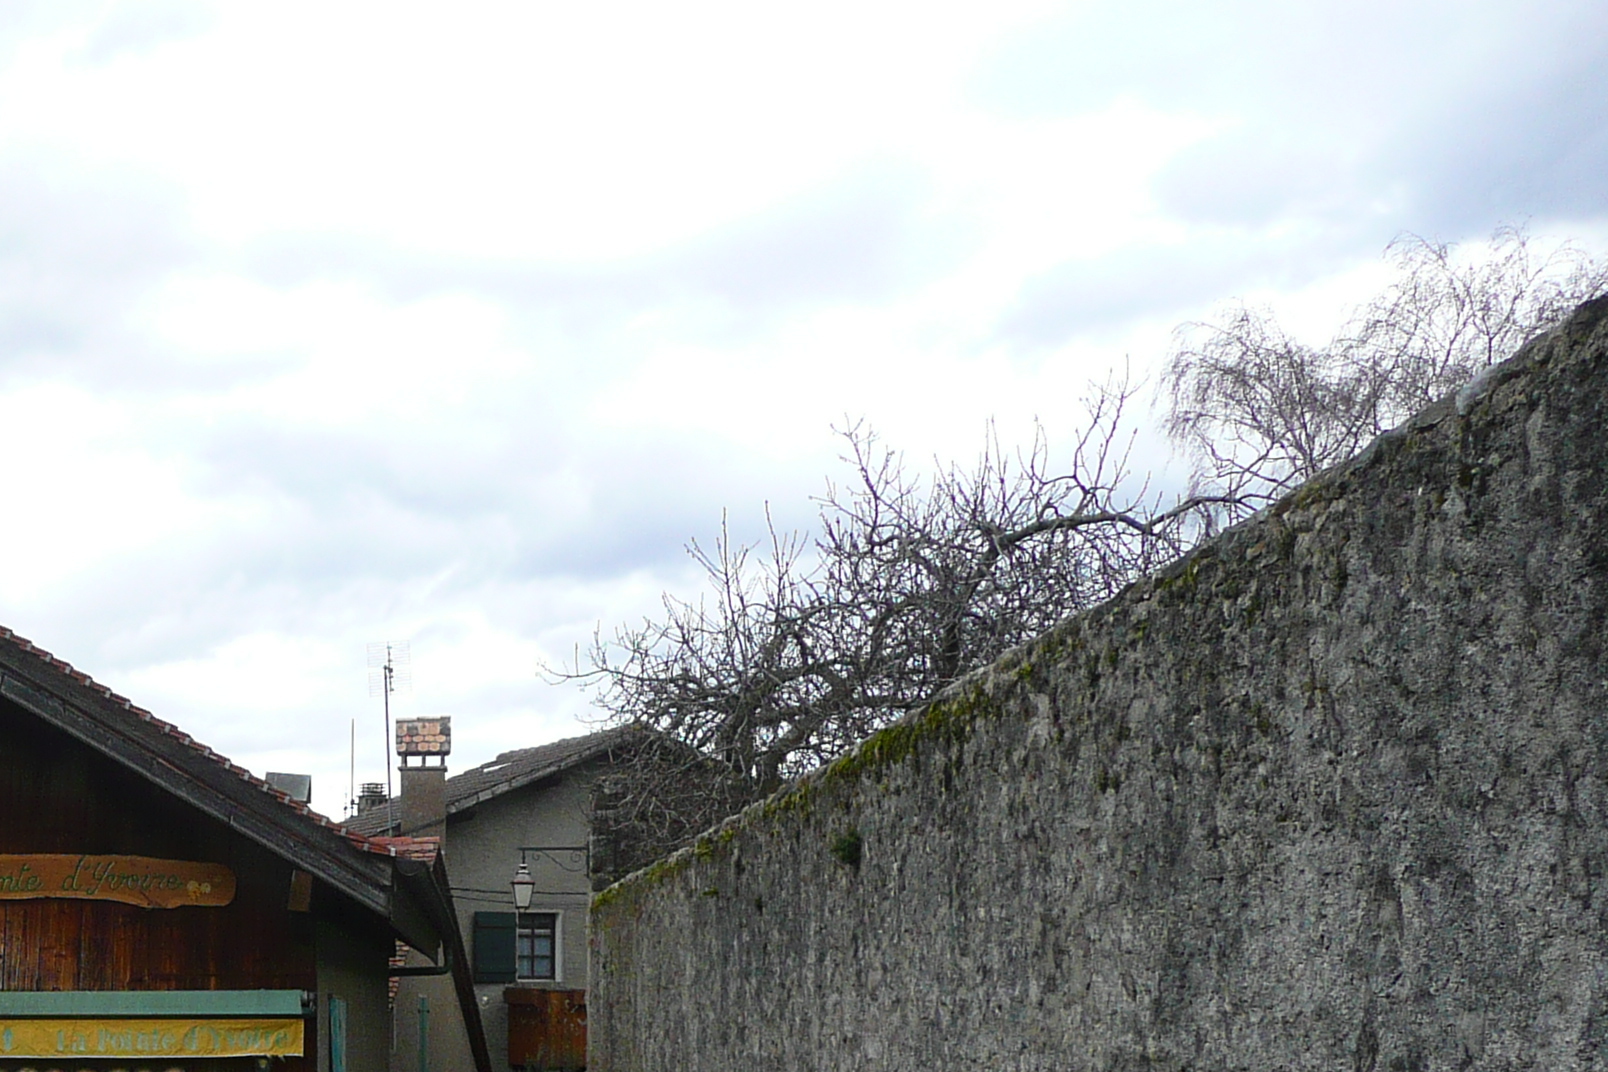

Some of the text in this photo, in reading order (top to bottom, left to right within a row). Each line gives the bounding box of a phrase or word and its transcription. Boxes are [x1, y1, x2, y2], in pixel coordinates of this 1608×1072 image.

[61, 854, 184, 895] d'Yvoire
[56, 1029, 87, 1052] La
[97, 1027, 177, 1052] Pointe
